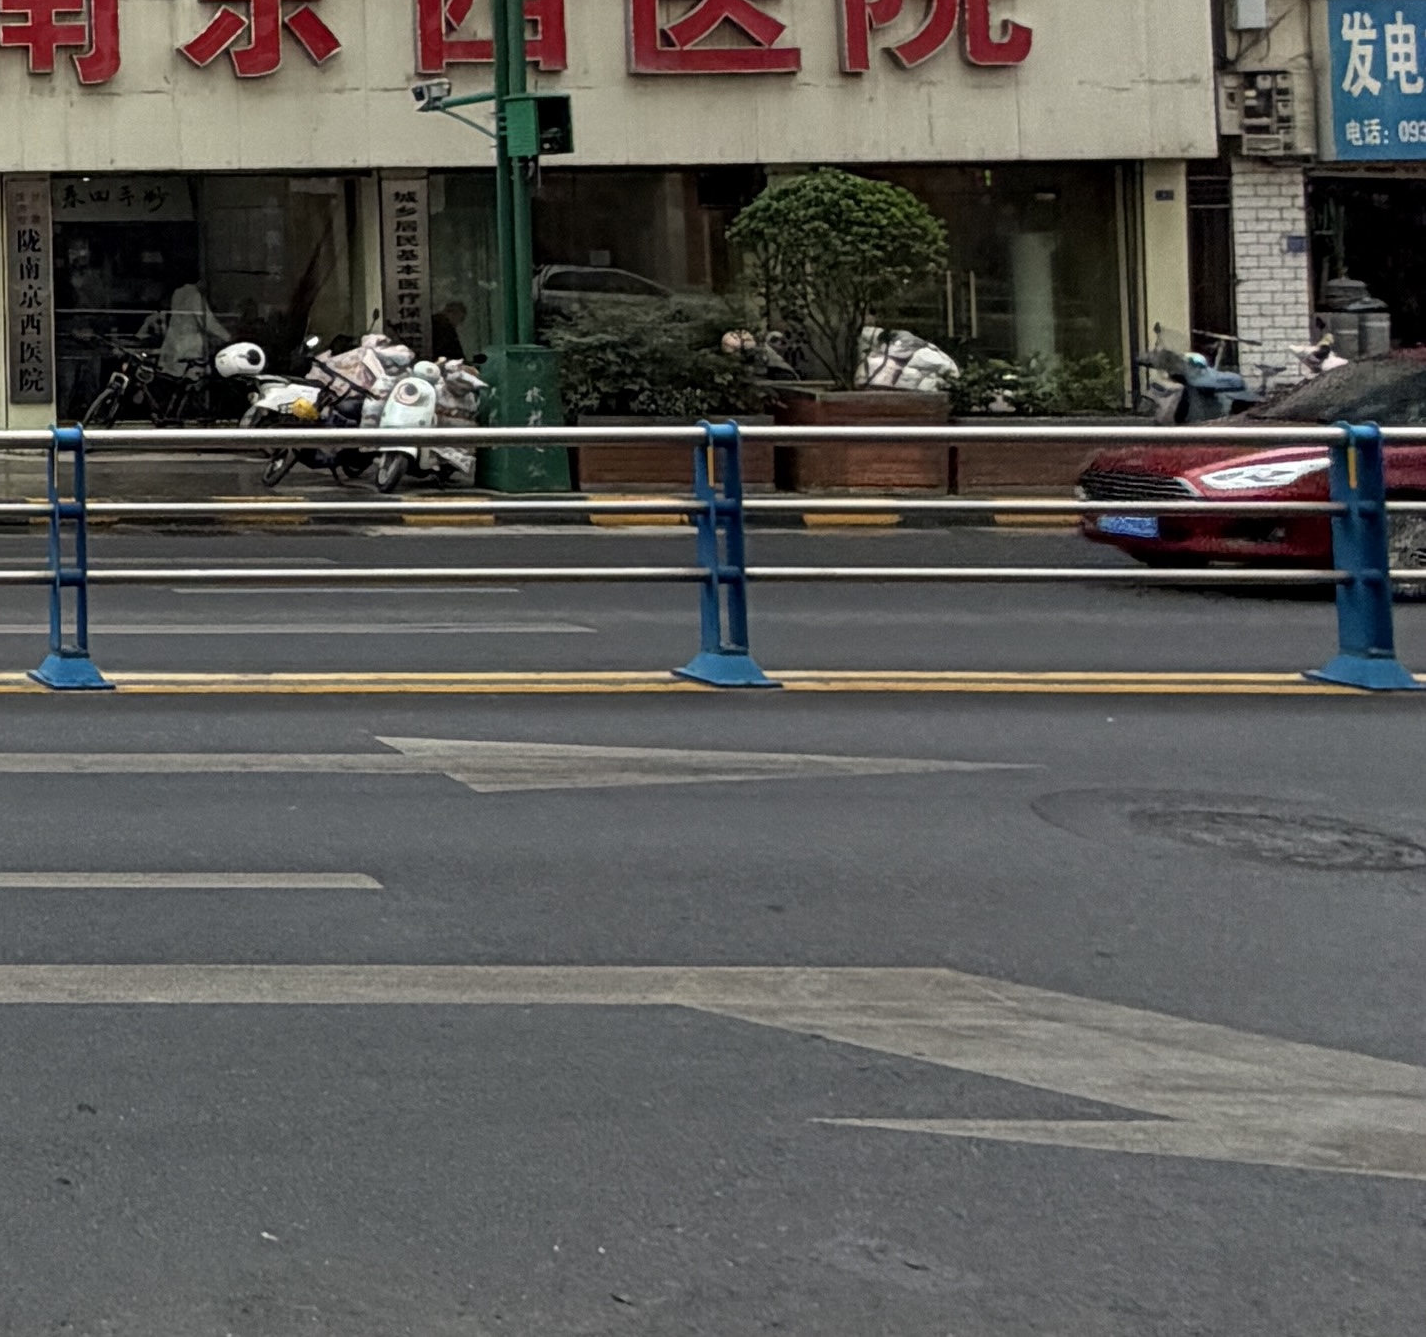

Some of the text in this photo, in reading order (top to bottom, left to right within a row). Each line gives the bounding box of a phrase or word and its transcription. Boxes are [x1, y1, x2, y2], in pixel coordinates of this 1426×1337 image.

[1341, 10, 1424, 98] 发电
[17, 229, 44, 392] 陇南京西医院
